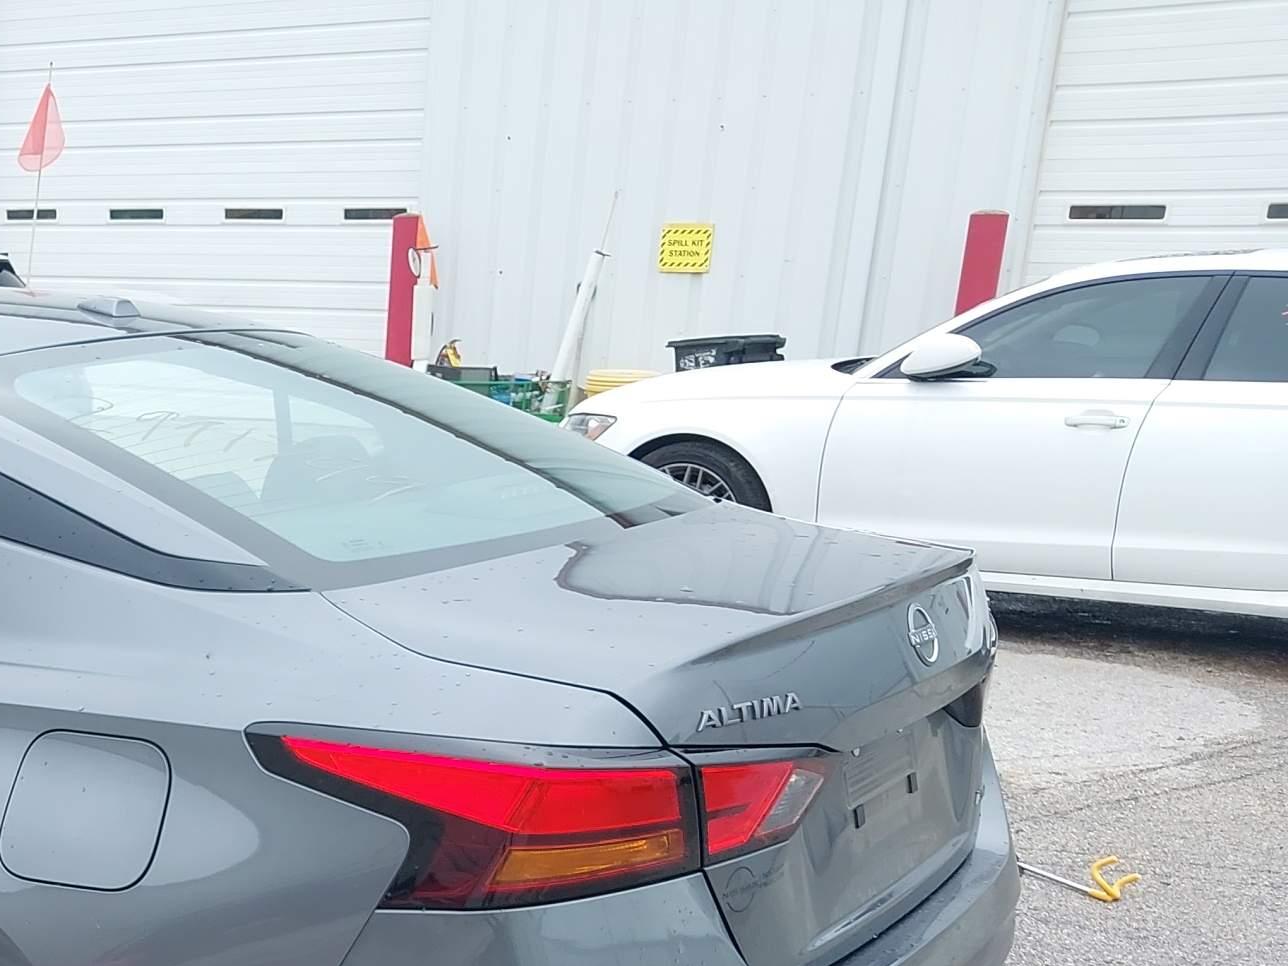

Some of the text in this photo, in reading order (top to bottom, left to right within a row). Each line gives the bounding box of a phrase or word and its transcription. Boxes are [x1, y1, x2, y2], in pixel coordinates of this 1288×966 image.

[667, 239, 705, 247] SPILL KIT
[668, 249, 701, 257] STATION
[910, 628, 937, 646] NISS
[696, 691, 803, 732] ALTIMA
